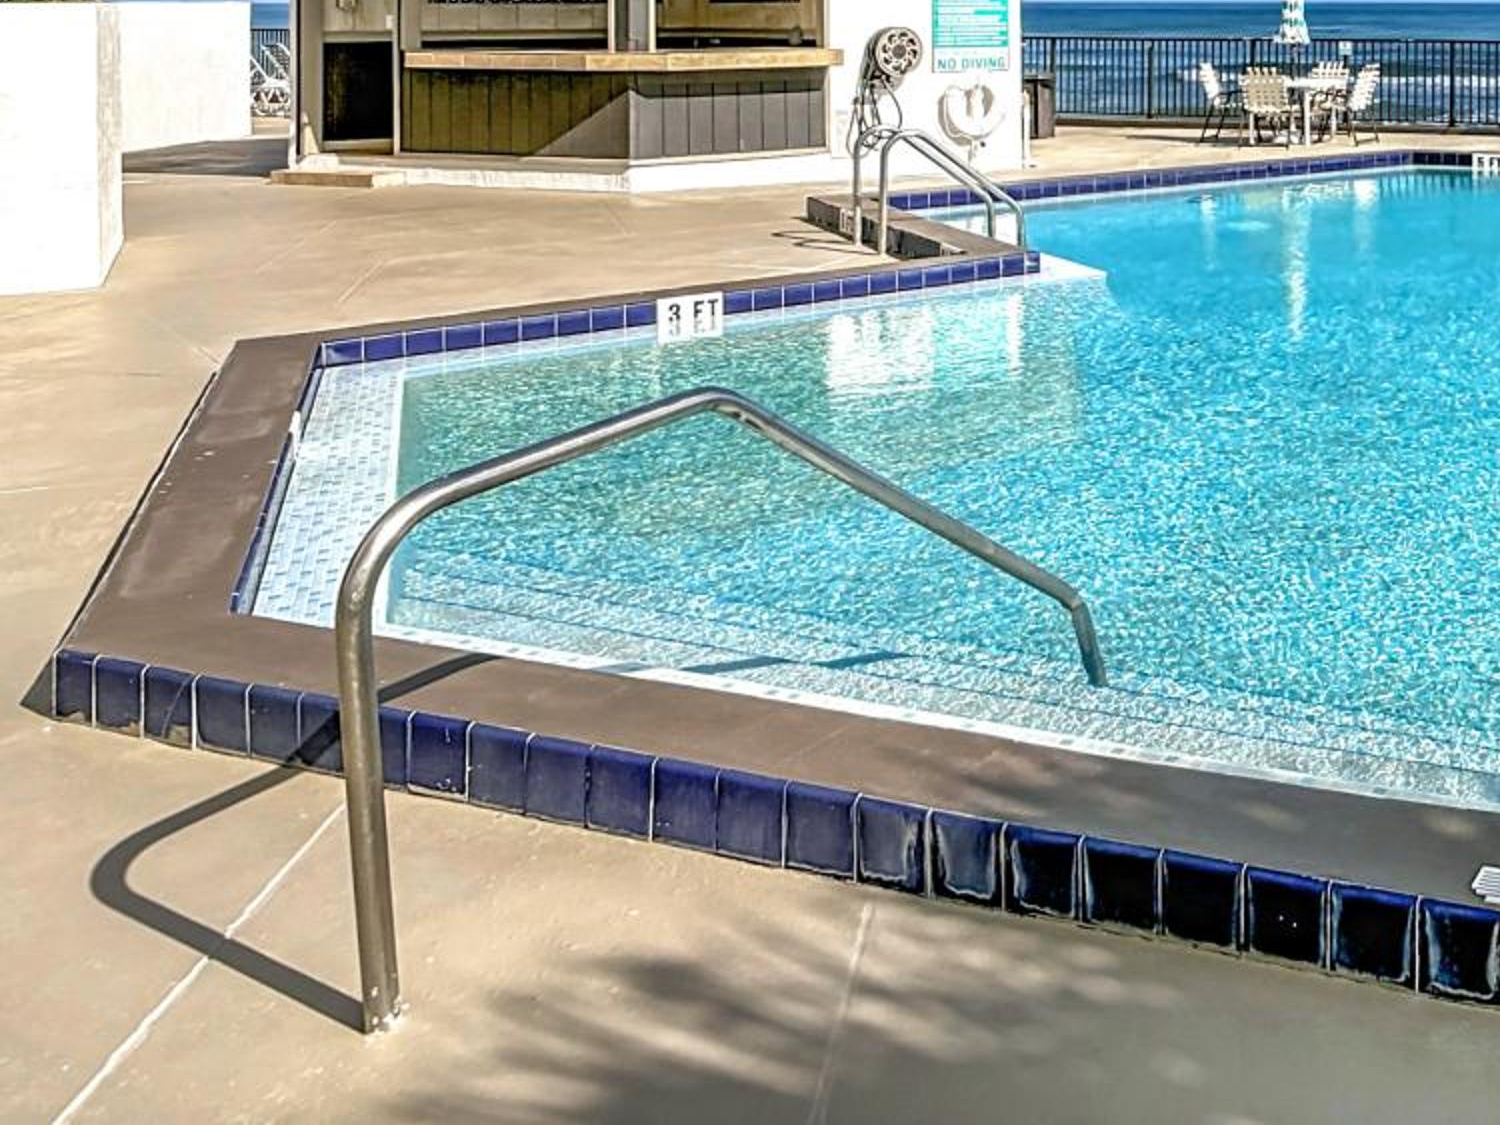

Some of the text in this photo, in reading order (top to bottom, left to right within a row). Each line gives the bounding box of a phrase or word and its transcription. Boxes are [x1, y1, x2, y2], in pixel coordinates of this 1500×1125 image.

[937, 56, 1006, 70] NO DIVING
[1477, 156, 1485, 168] 5
[668, 298, 719, 322] 3 FT
